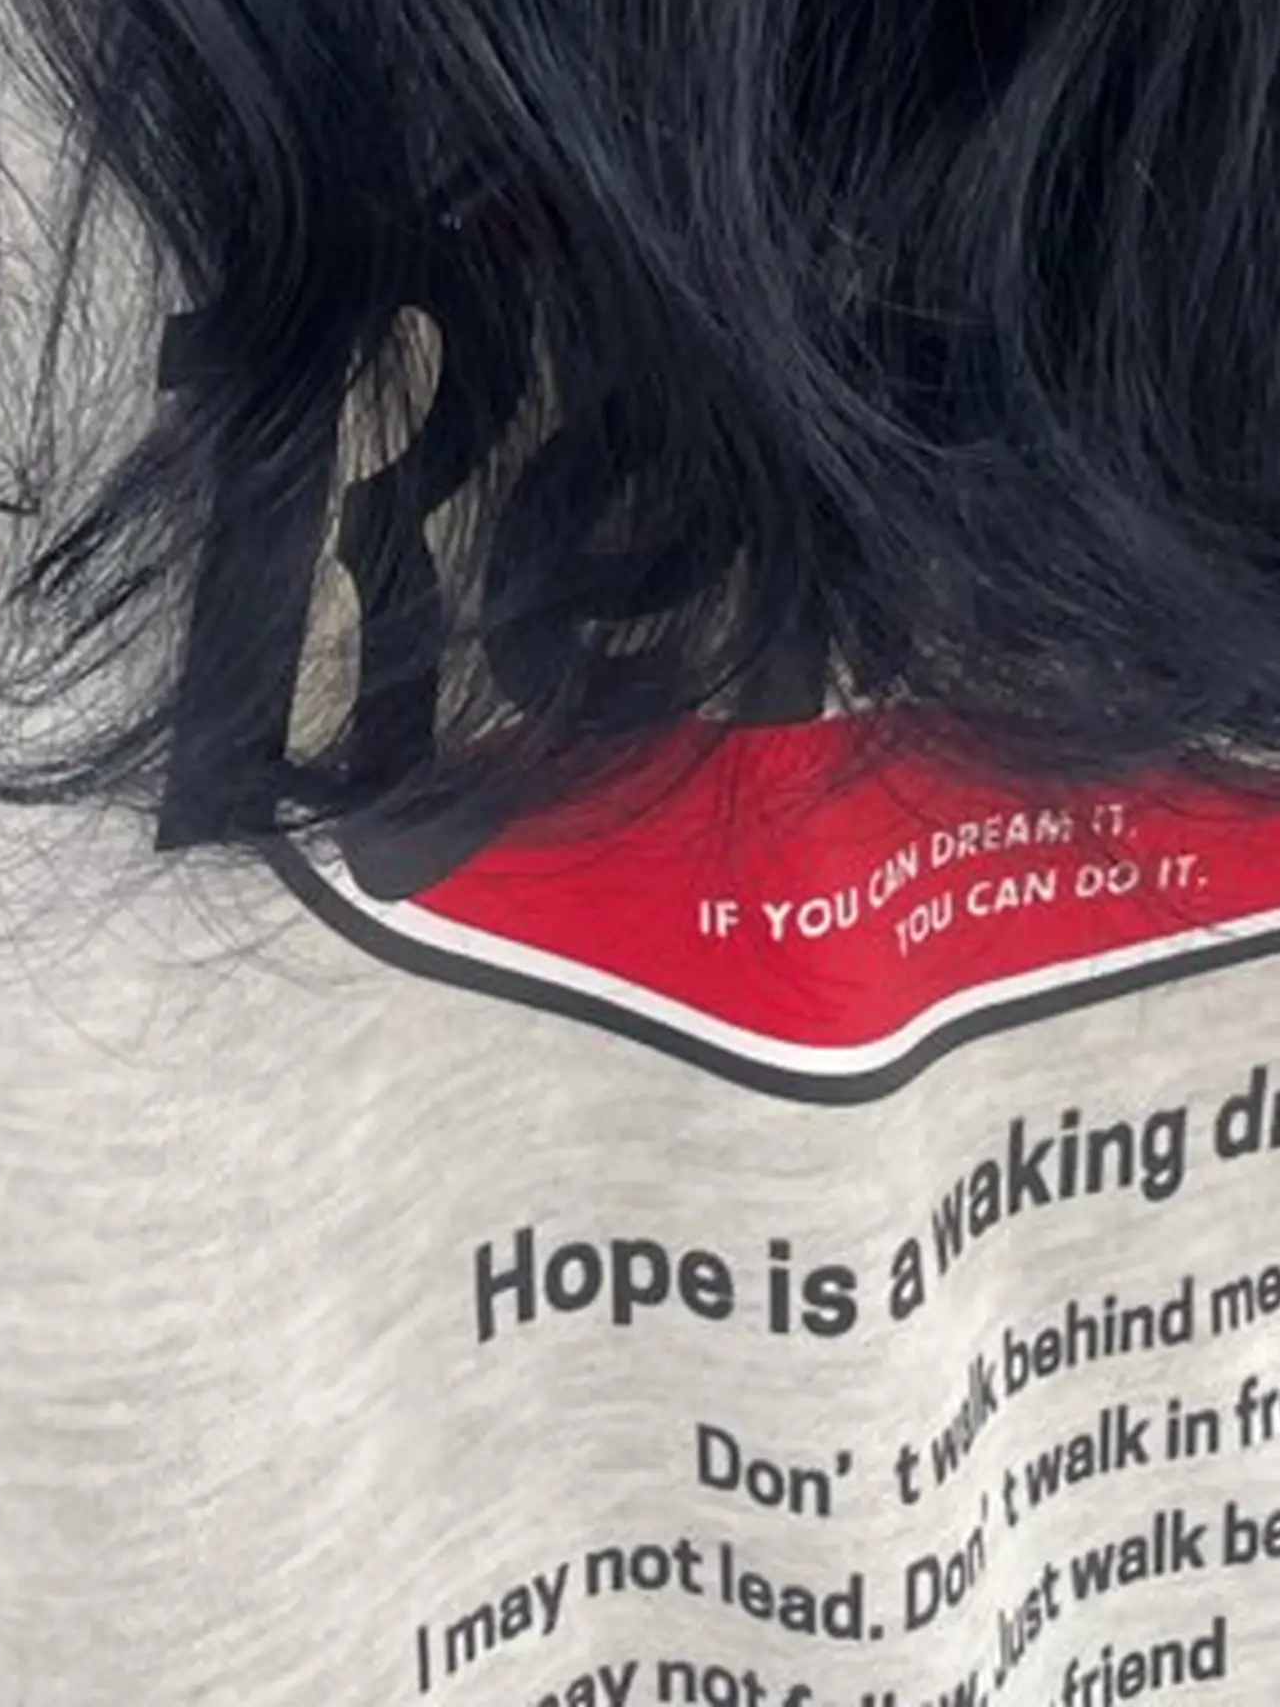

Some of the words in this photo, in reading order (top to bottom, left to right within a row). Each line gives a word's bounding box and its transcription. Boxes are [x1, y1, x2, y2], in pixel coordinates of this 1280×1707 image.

[698, 900, 740, 938] IF
[762, 888, 860, 941] YOU
[867, 841, 918, 909] CAN
[930, 808, 1074, 868] DREAM
[895, 892, 954, 959] YOU
[966, 866, 1058, 917] CAN
[1075, 859, 1141, 898] DO
[1158, 852, 1209, 891] IT.
[475, 1225, 736, 1344] Hope
[768, 1238, 858, 1336] is
[889, 1237, 925, 1321] a
[931, 1107, 1188, 1277] waking
[931, 1352, 998, 1485] walk
[1003, 1275, 1194, 1397] behind
[418, 1624, 430, 1693] I
[444, 1562, 570, 1675] may
[584, 1537, 703, 1596] not
[720, 1541, 884, 1641] lead.
[1024, 1403, 1151, 1508] walk
[1166, 1398, 1221, 1461] in
[657, 1660, 767, 1707] not
[992, 1561, 1061, 1688] Just
[1070, 1509, 1208, 1601] walk
[1062, 1616, 1228, 1707] friend
